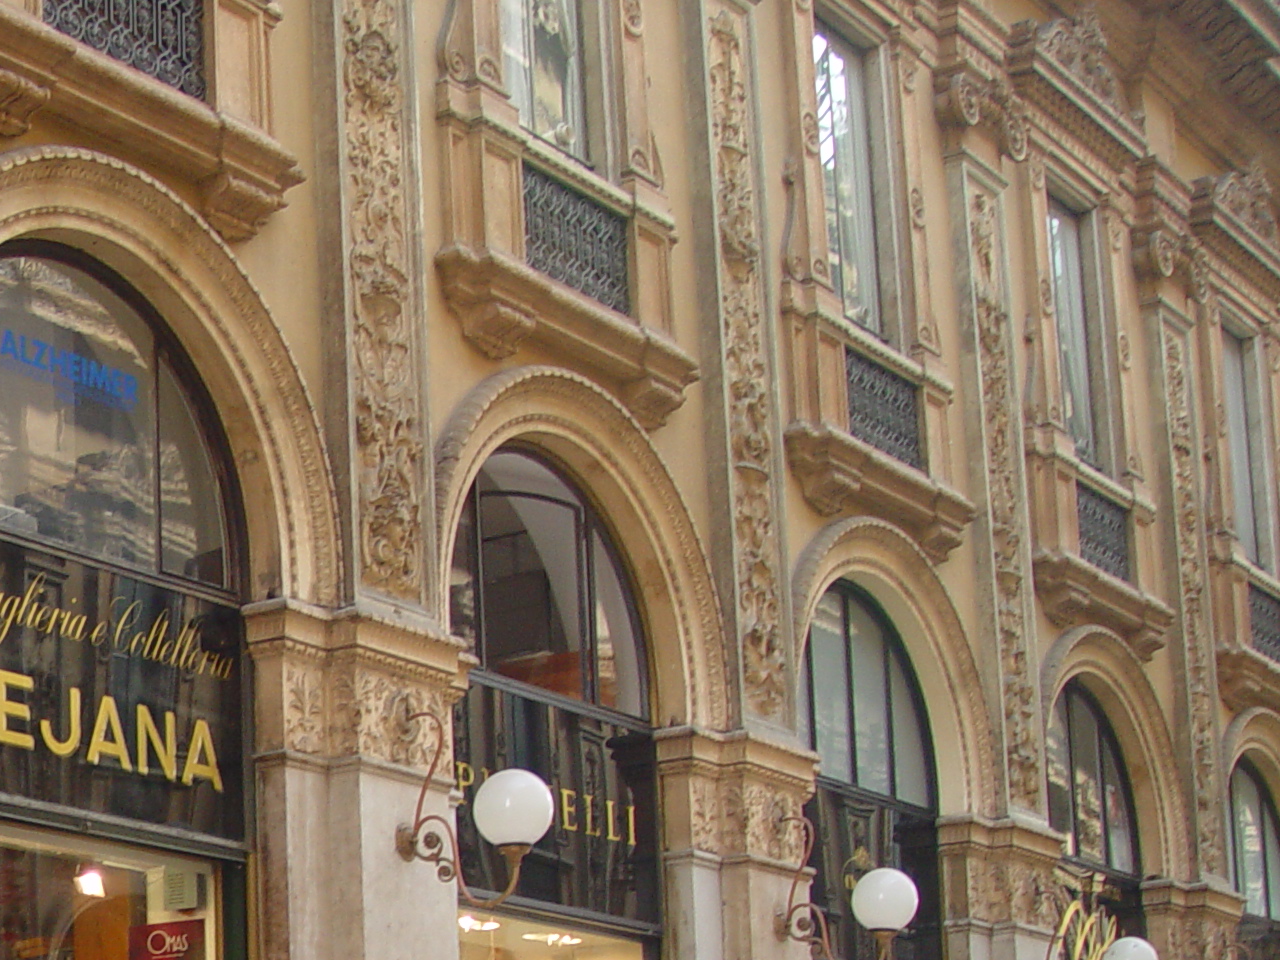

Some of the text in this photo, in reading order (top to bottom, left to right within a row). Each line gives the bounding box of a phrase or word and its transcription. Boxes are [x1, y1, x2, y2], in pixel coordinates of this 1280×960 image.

[0, 329, 139, 403] ALZHEIMER
[90, 620, 108, 647] e
[109, 595, 234, 680] Coltelleria
